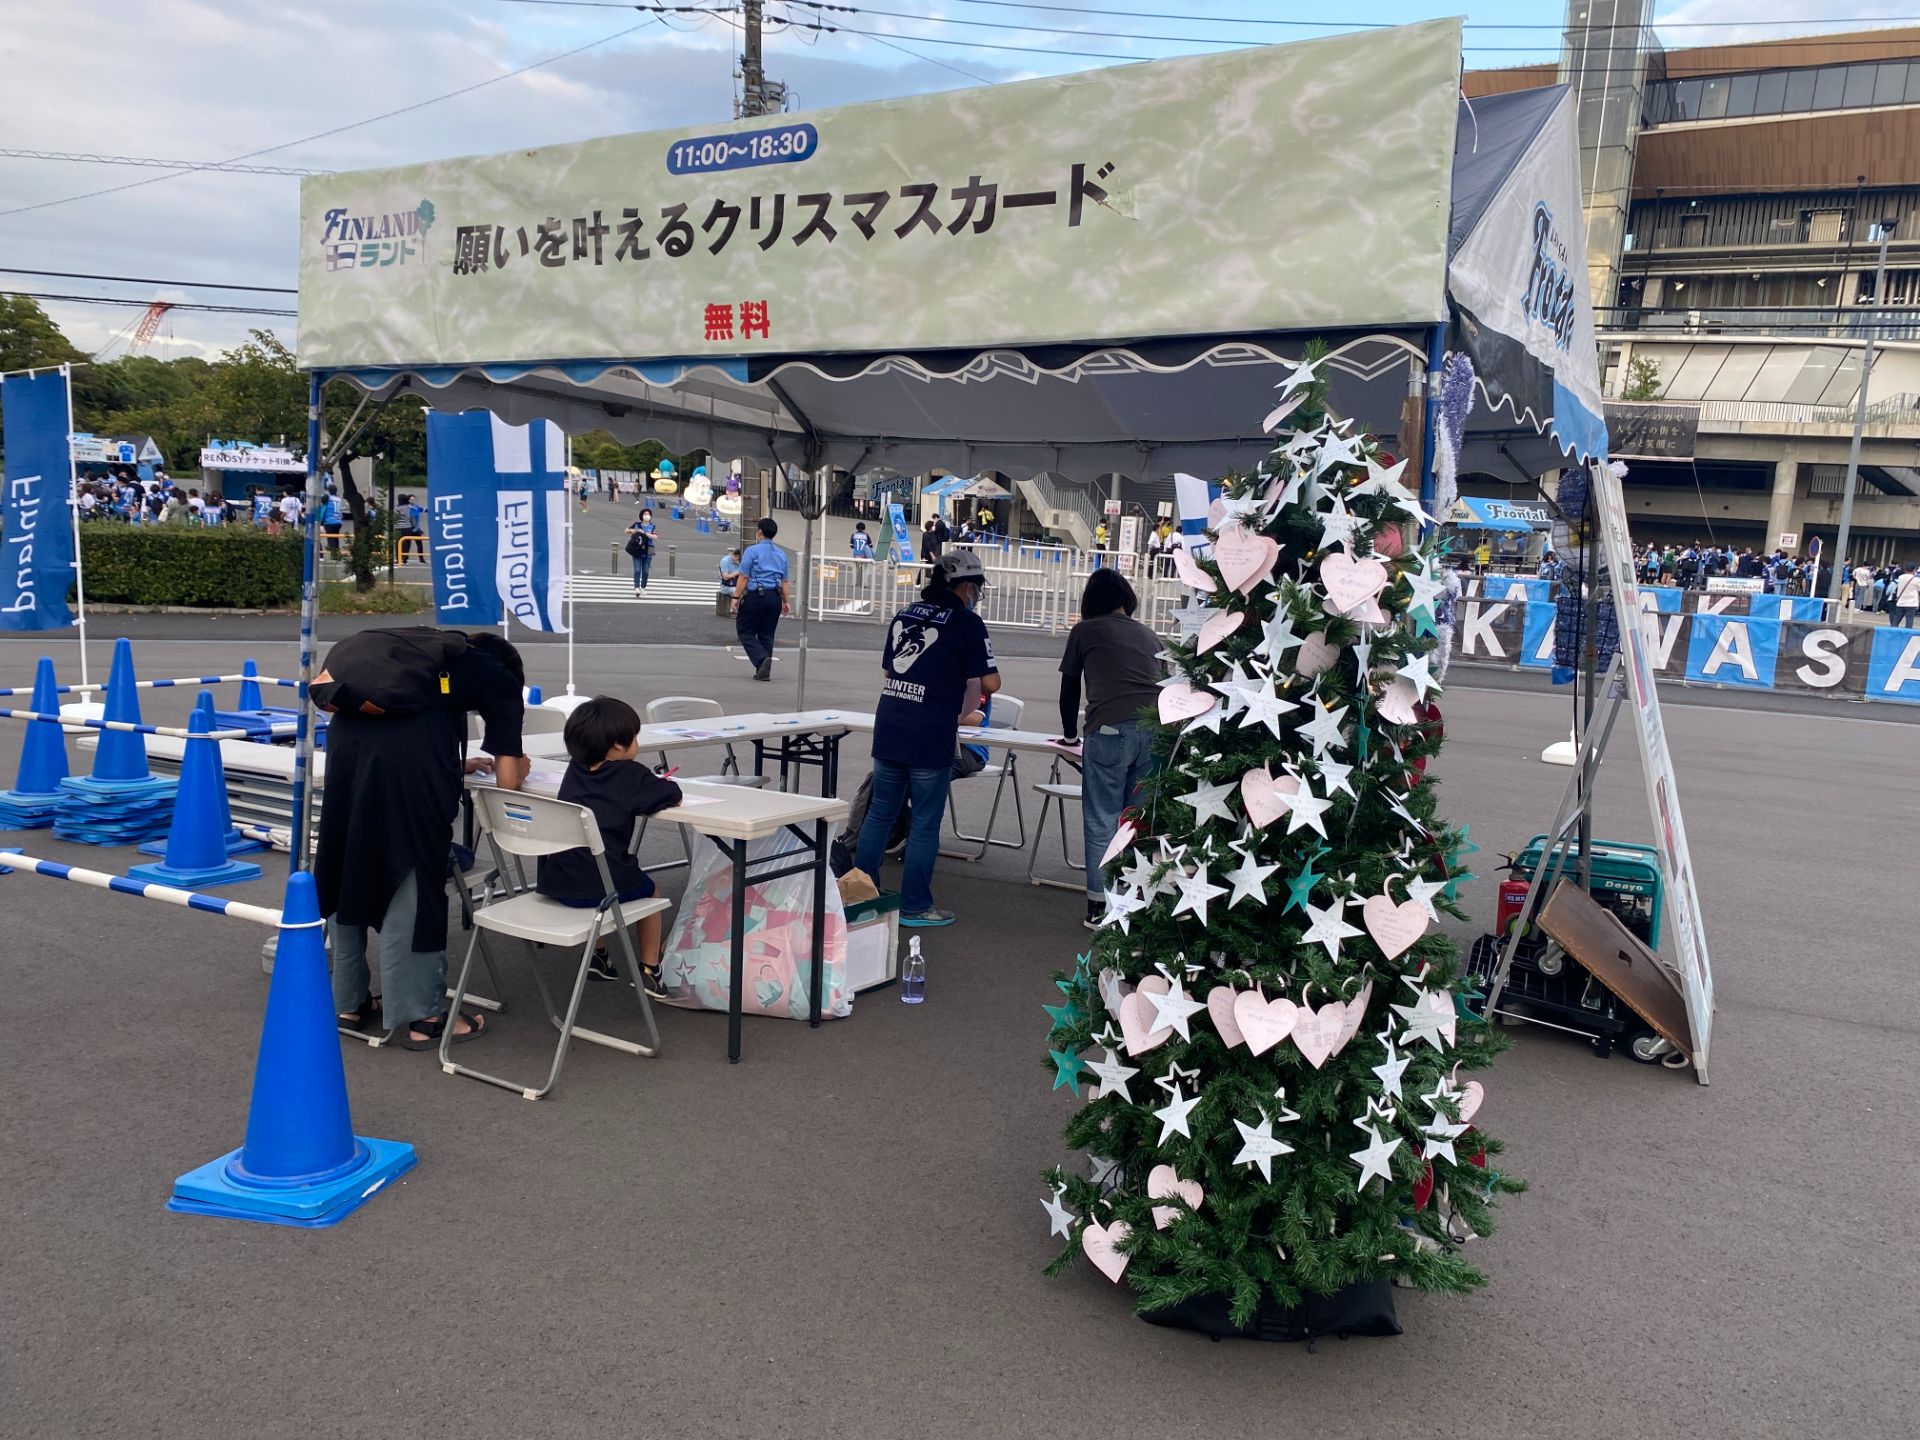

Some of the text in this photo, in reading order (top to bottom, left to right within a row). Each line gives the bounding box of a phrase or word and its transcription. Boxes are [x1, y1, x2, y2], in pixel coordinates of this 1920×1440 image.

[320, 208, 420, 245] FINLAND
[452, 161, 1115, 276] 願いを叶えるクリスマスカード
[360, 238, 417, 268] ランド
[703, 300, 771, 341] 無料
[1605, 880, 1643, 892] Denyo
